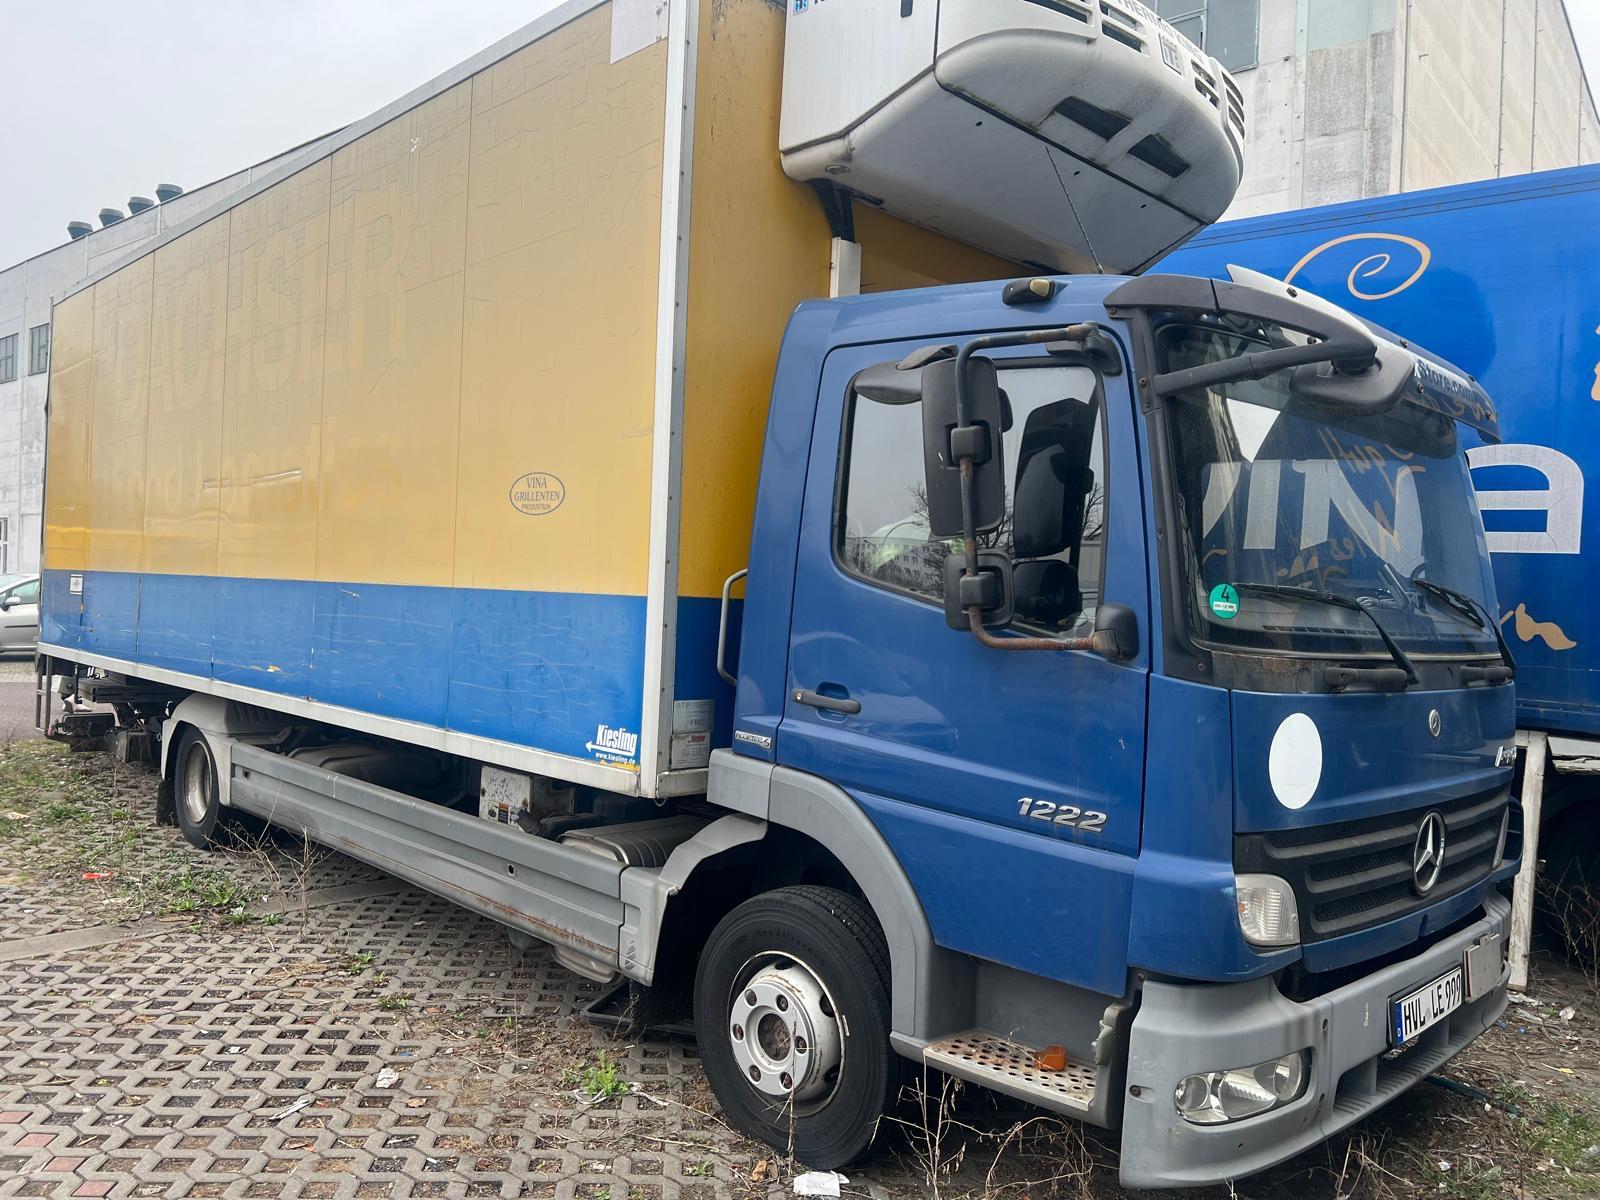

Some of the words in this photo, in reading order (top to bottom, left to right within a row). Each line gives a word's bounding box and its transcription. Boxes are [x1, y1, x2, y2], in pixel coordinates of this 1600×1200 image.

[526, 476, 547, 489] VINA
[514, 490, 561, 502] GRILLENTEN
[1221, 585, 1230, 602] 4
[596, 723, 638, 753] Kiesling
[595, 752, 636, 765] www.kiesling.de
[1017, 797, 1107, 833] 1222
[1403, 998, 1426, 1036] HVL
[1430, 983, 1445, 1019] LE
[1445, 973, 1461, 1010] 999
